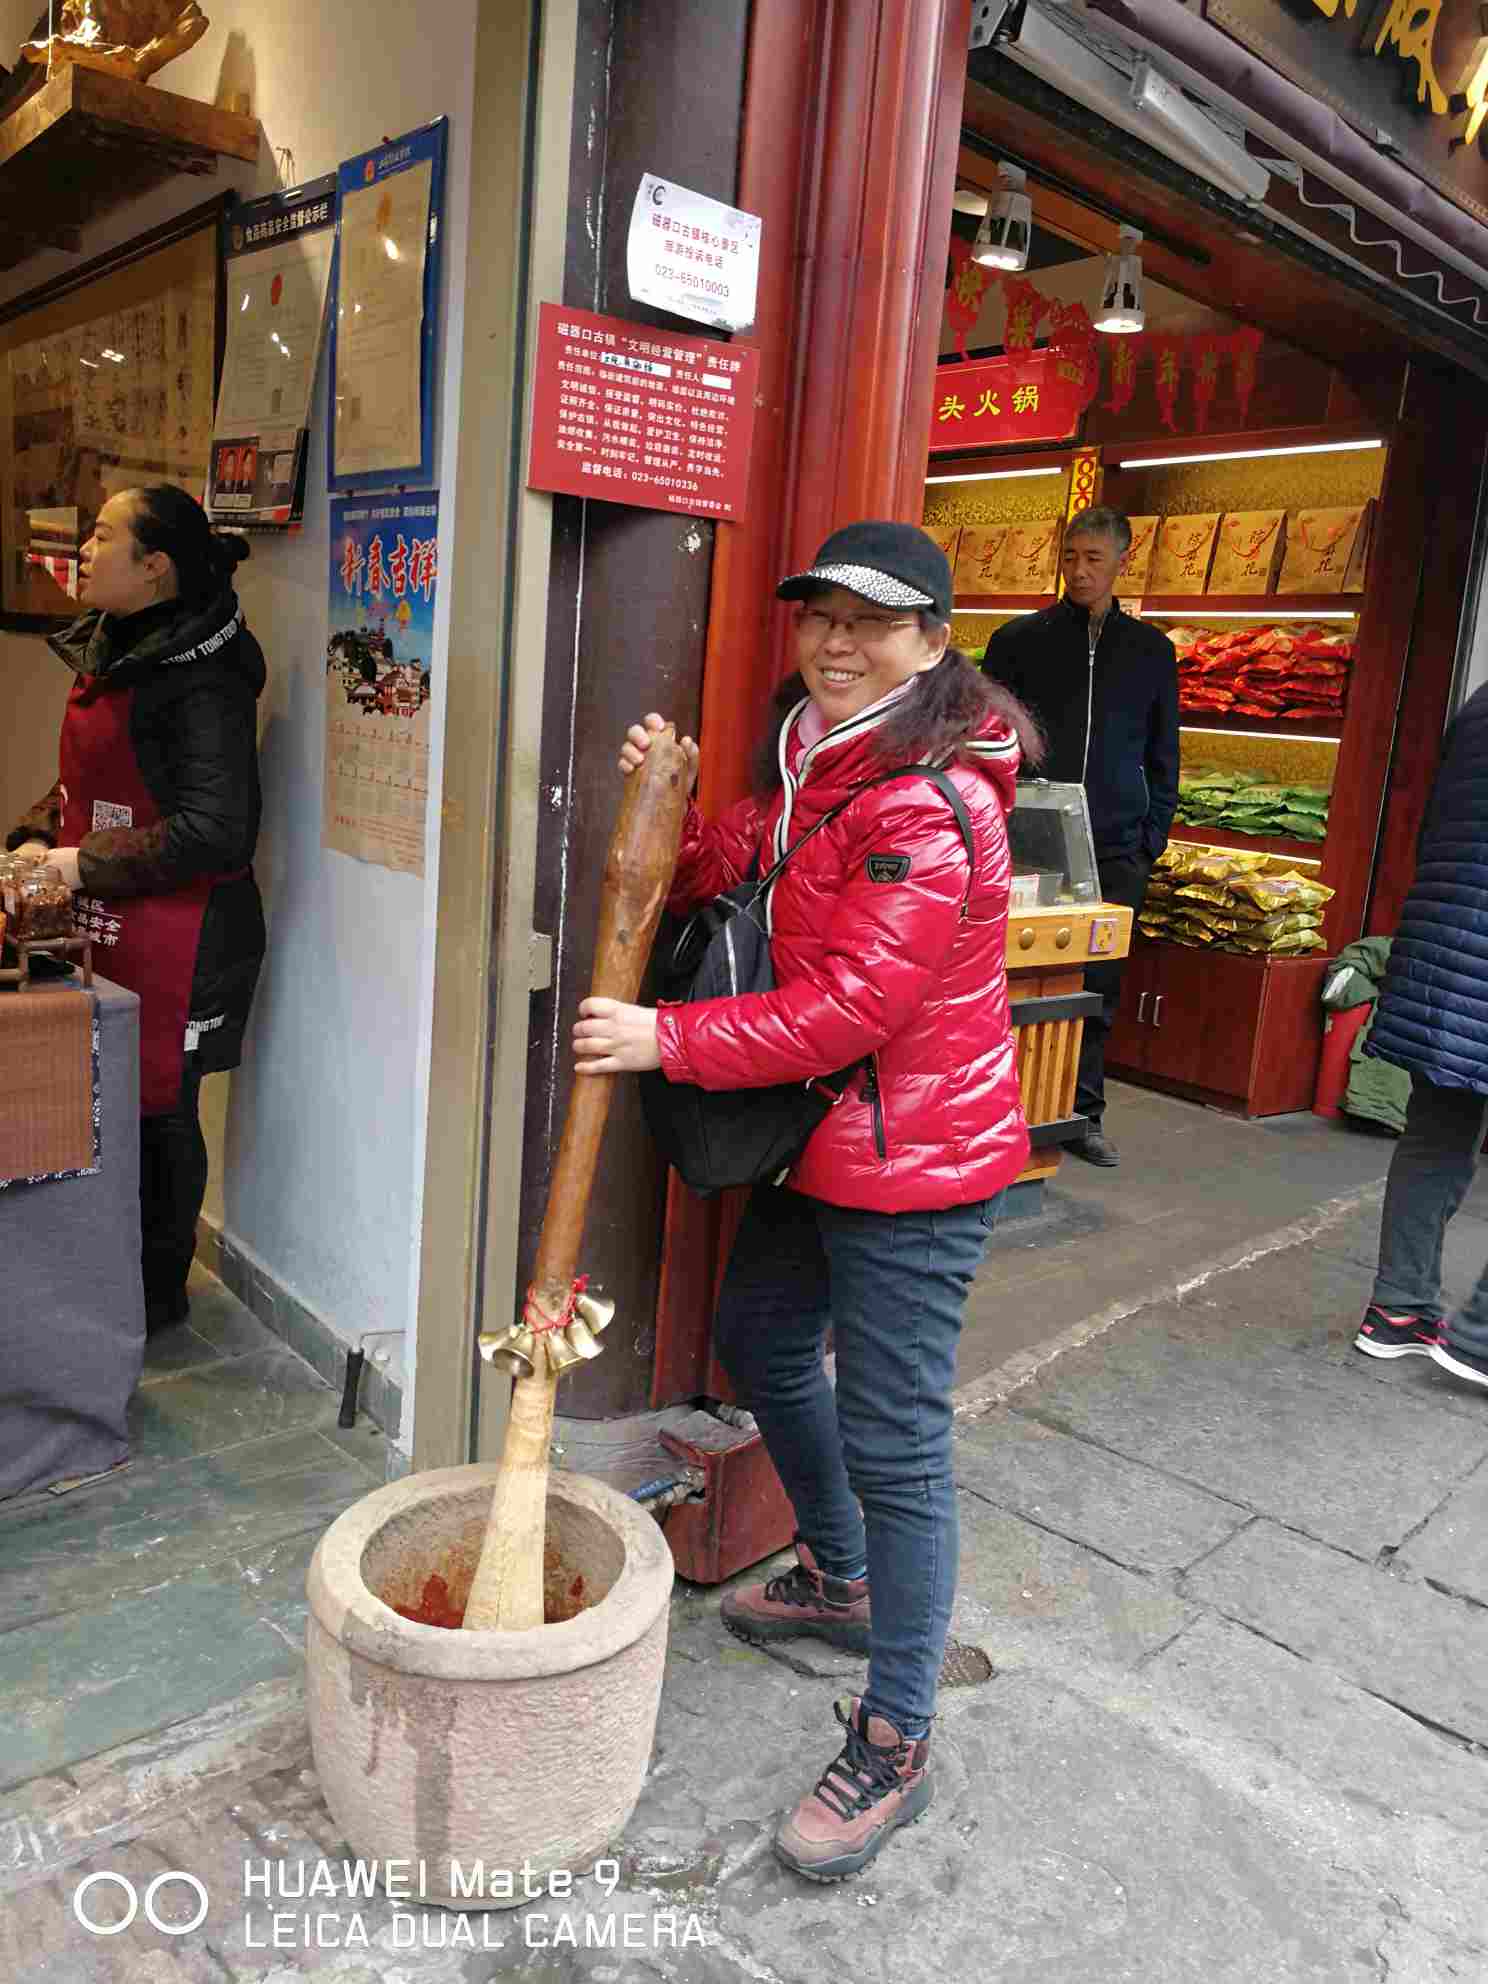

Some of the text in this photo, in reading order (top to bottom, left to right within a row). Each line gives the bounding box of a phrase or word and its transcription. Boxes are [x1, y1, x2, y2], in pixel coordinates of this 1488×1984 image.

[938, 385, 1040, 423] 头火锅
[341, 534, 439, 602] 新春吉祥
